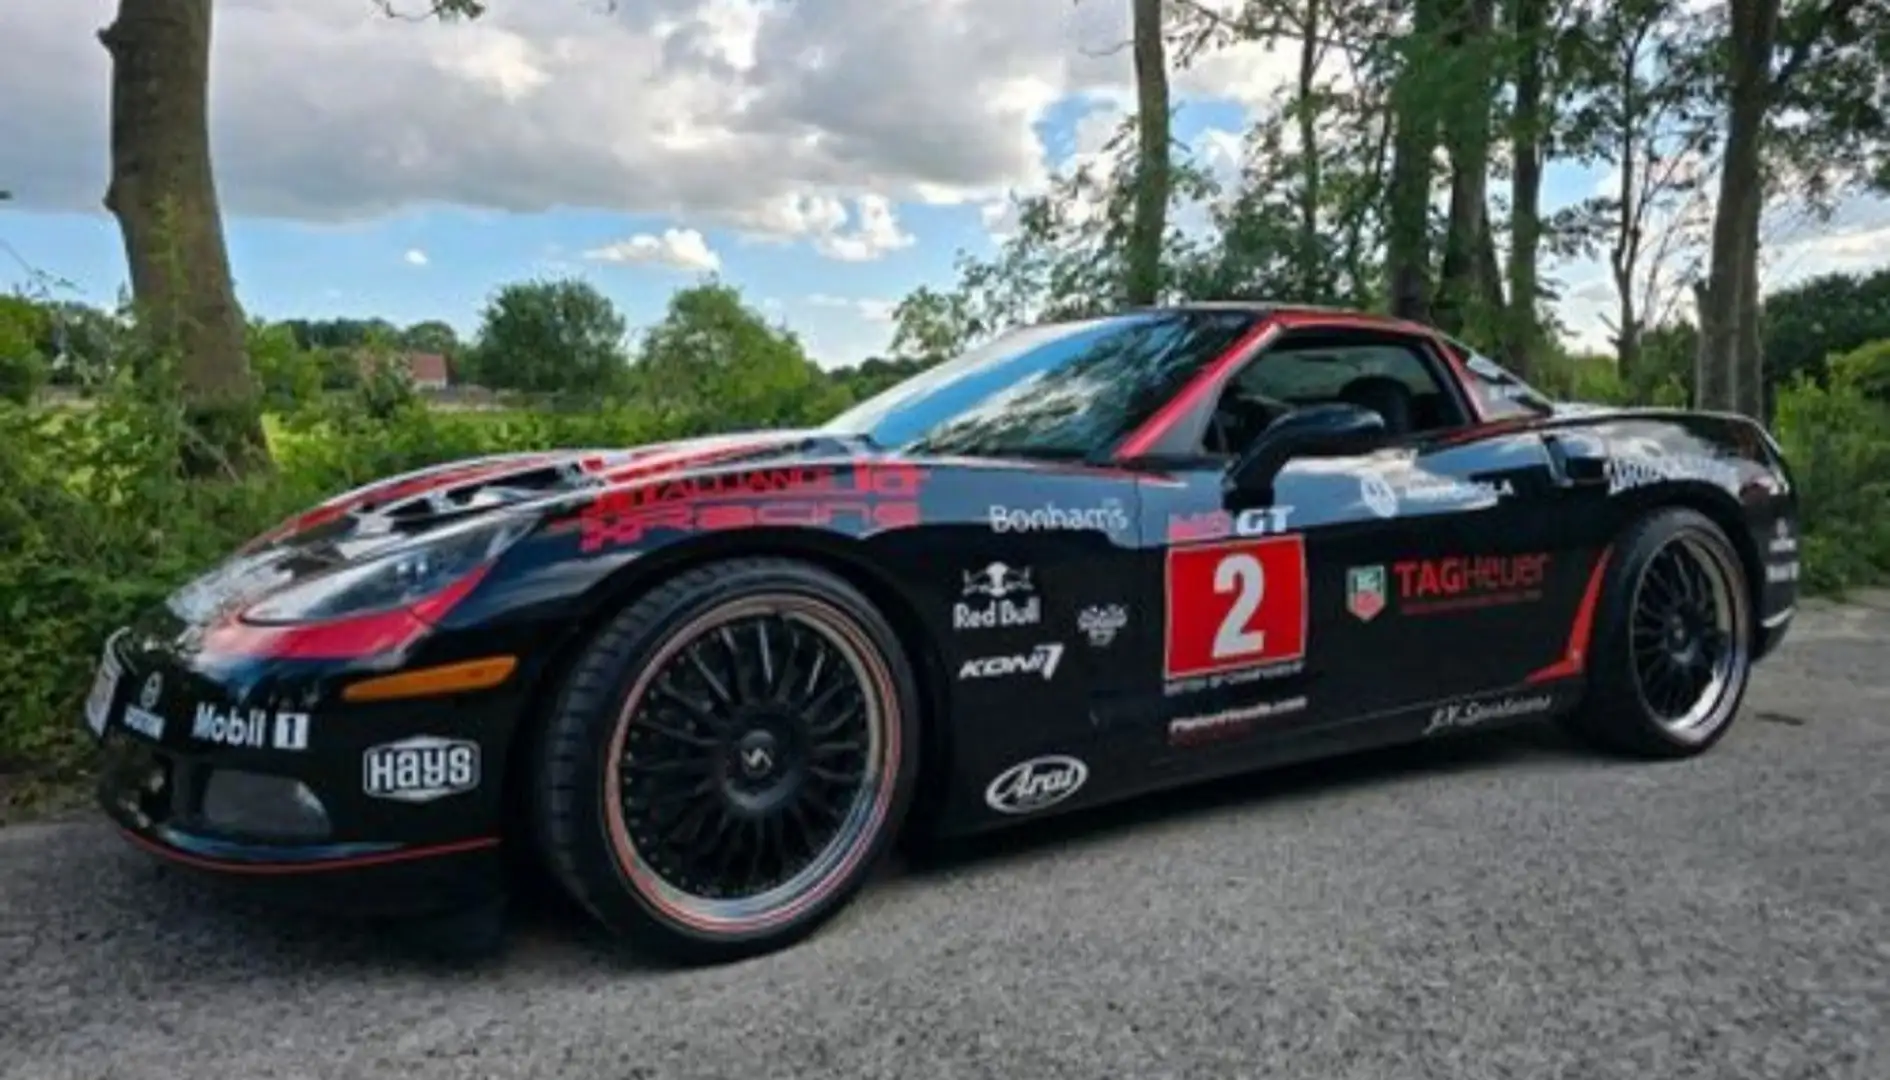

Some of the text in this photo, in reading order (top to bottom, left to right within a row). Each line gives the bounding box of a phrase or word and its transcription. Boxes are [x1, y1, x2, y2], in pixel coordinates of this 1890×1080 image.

[953, 597, 1042, 630] Red Bull
[1212, 552, 1266, 658] 2
[192, 702, 266, 748] Mobil
[370, 747, 471, 791] Hays
[997, 763, 1077, 799] Arai
